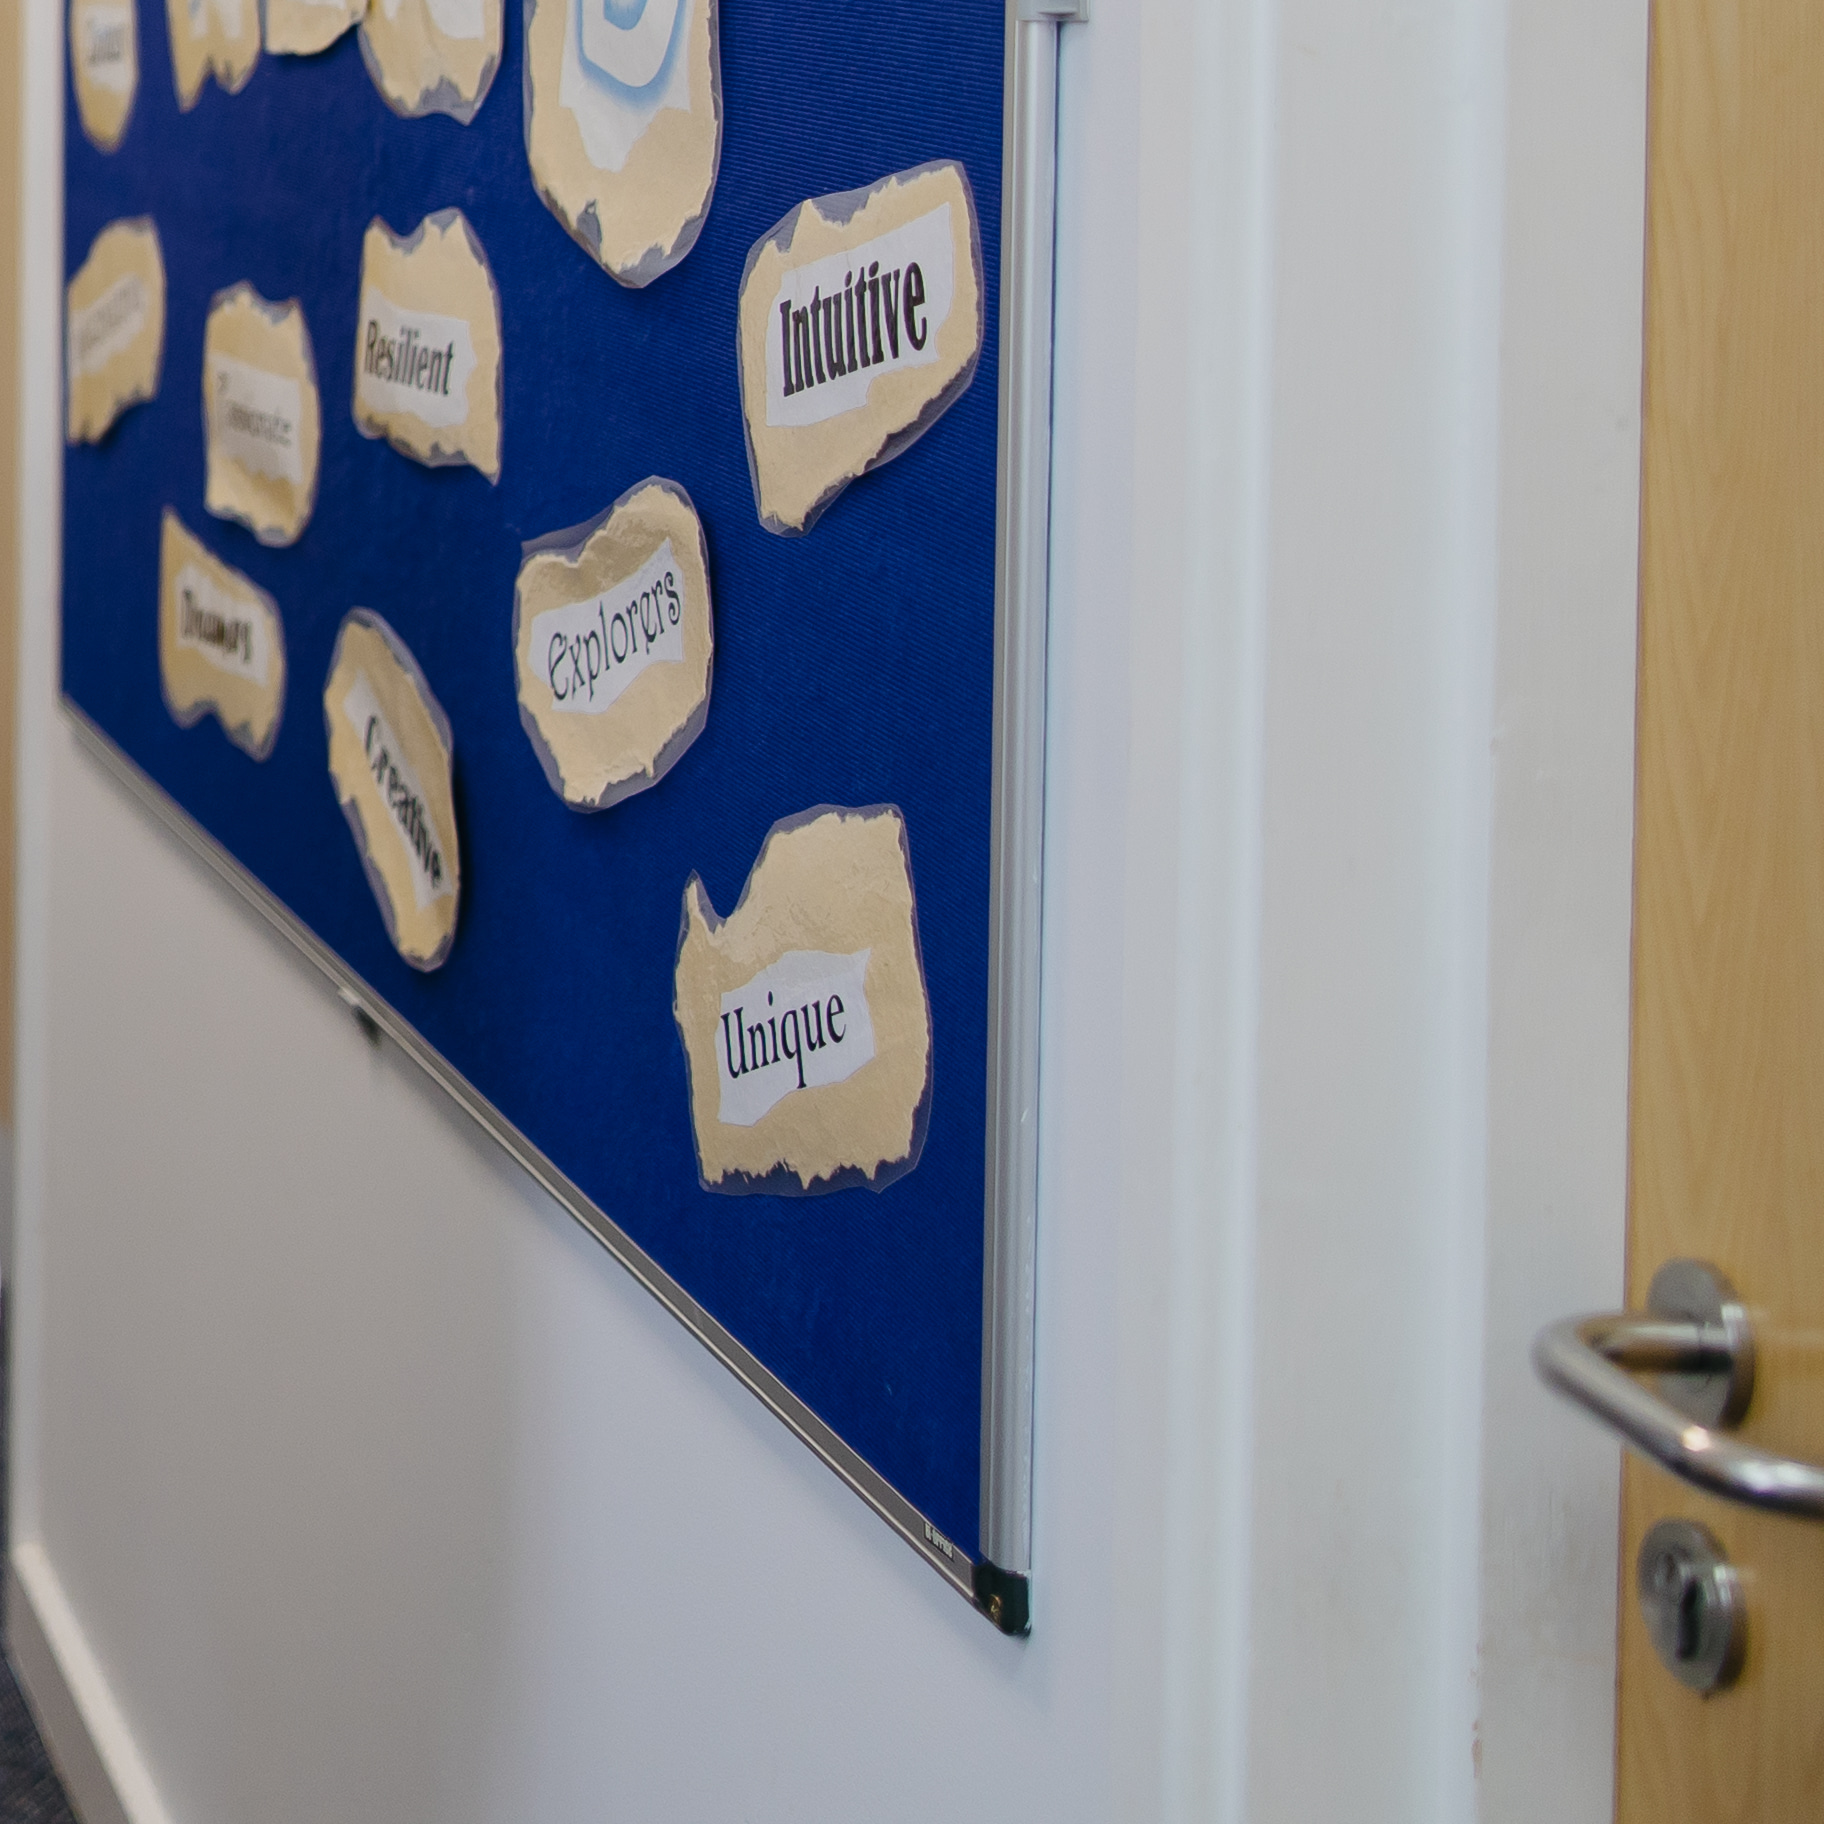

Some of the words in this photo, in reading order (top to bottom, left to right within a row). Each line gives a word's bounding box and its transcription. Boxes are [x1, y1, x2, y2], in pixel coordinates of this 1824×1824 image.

[364, 319, 454, 396] Resilient
[779, 260, 927, 397] Intuitive
[364, 715, 442, 889] Creative
[721, 991, 846, 1089] Unique
